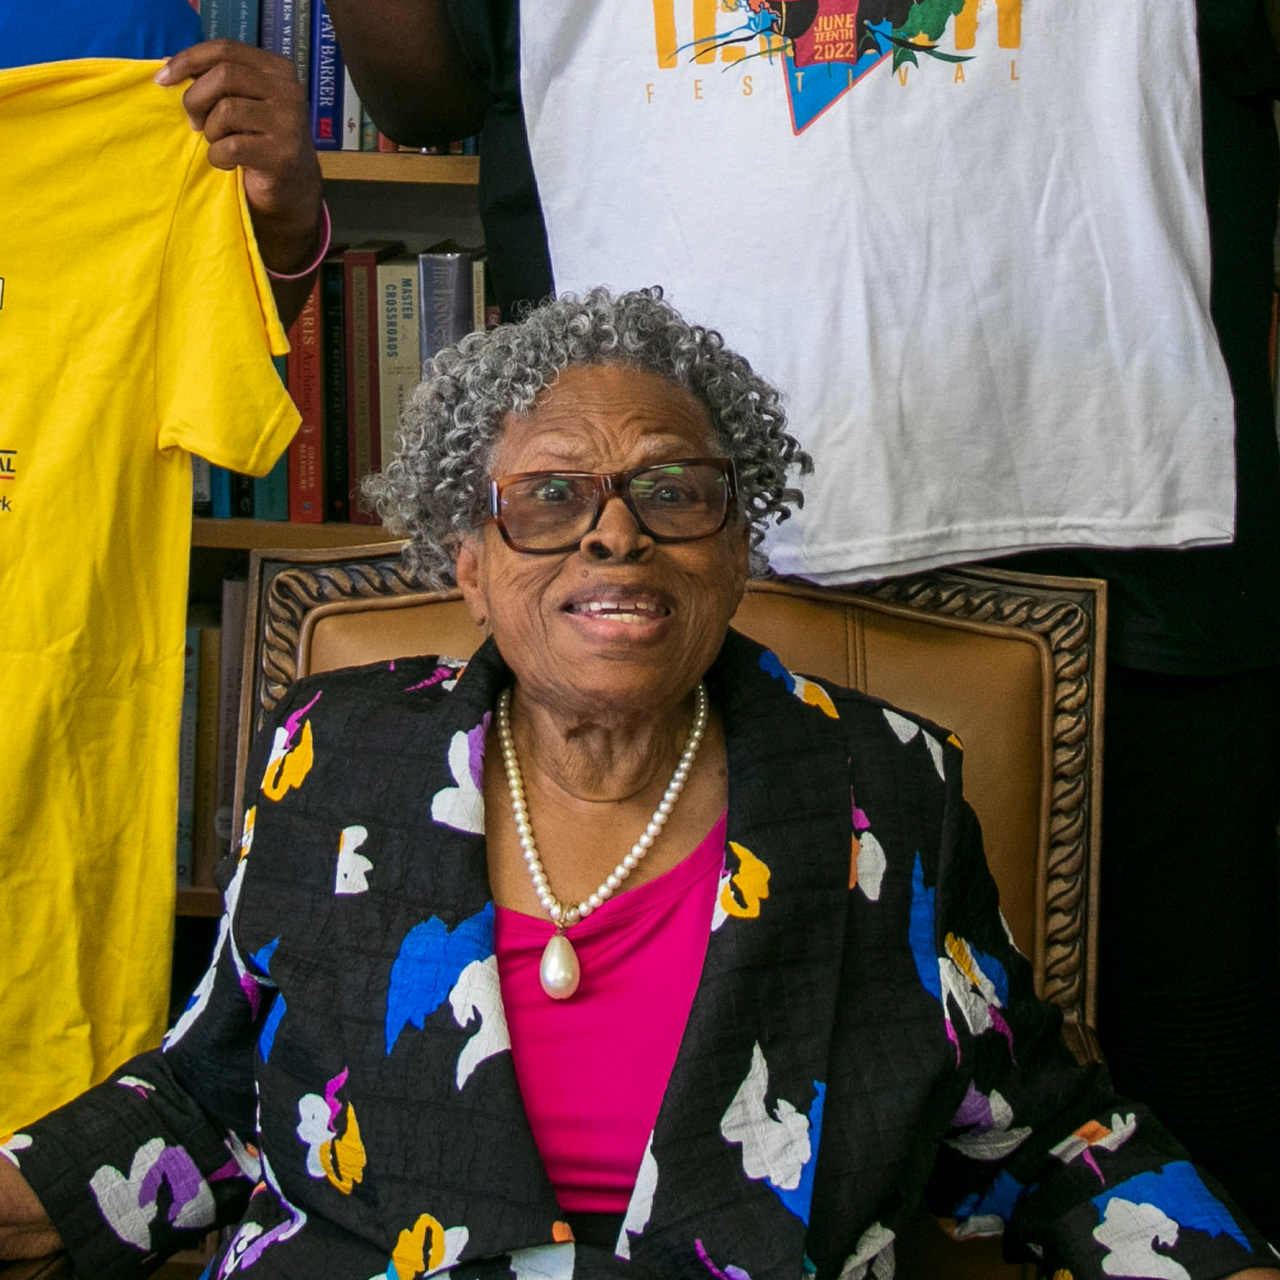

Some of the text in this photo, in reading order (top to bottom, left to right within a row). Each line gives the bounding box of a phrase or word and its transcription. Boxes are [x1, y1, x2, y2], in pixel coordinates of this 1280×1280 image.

[813, 14, 854, 31] JUNE
[814, 29, 854, 42] TEENTH
[813, 42, 855, 60] 2022
[320, 54, 336, 106] BARKER
[646, 60, 1021, 104] FESTIVAL
[401, 278, 413, 321] MASTER
[384, 284, 398, 359] CROSSROADS
